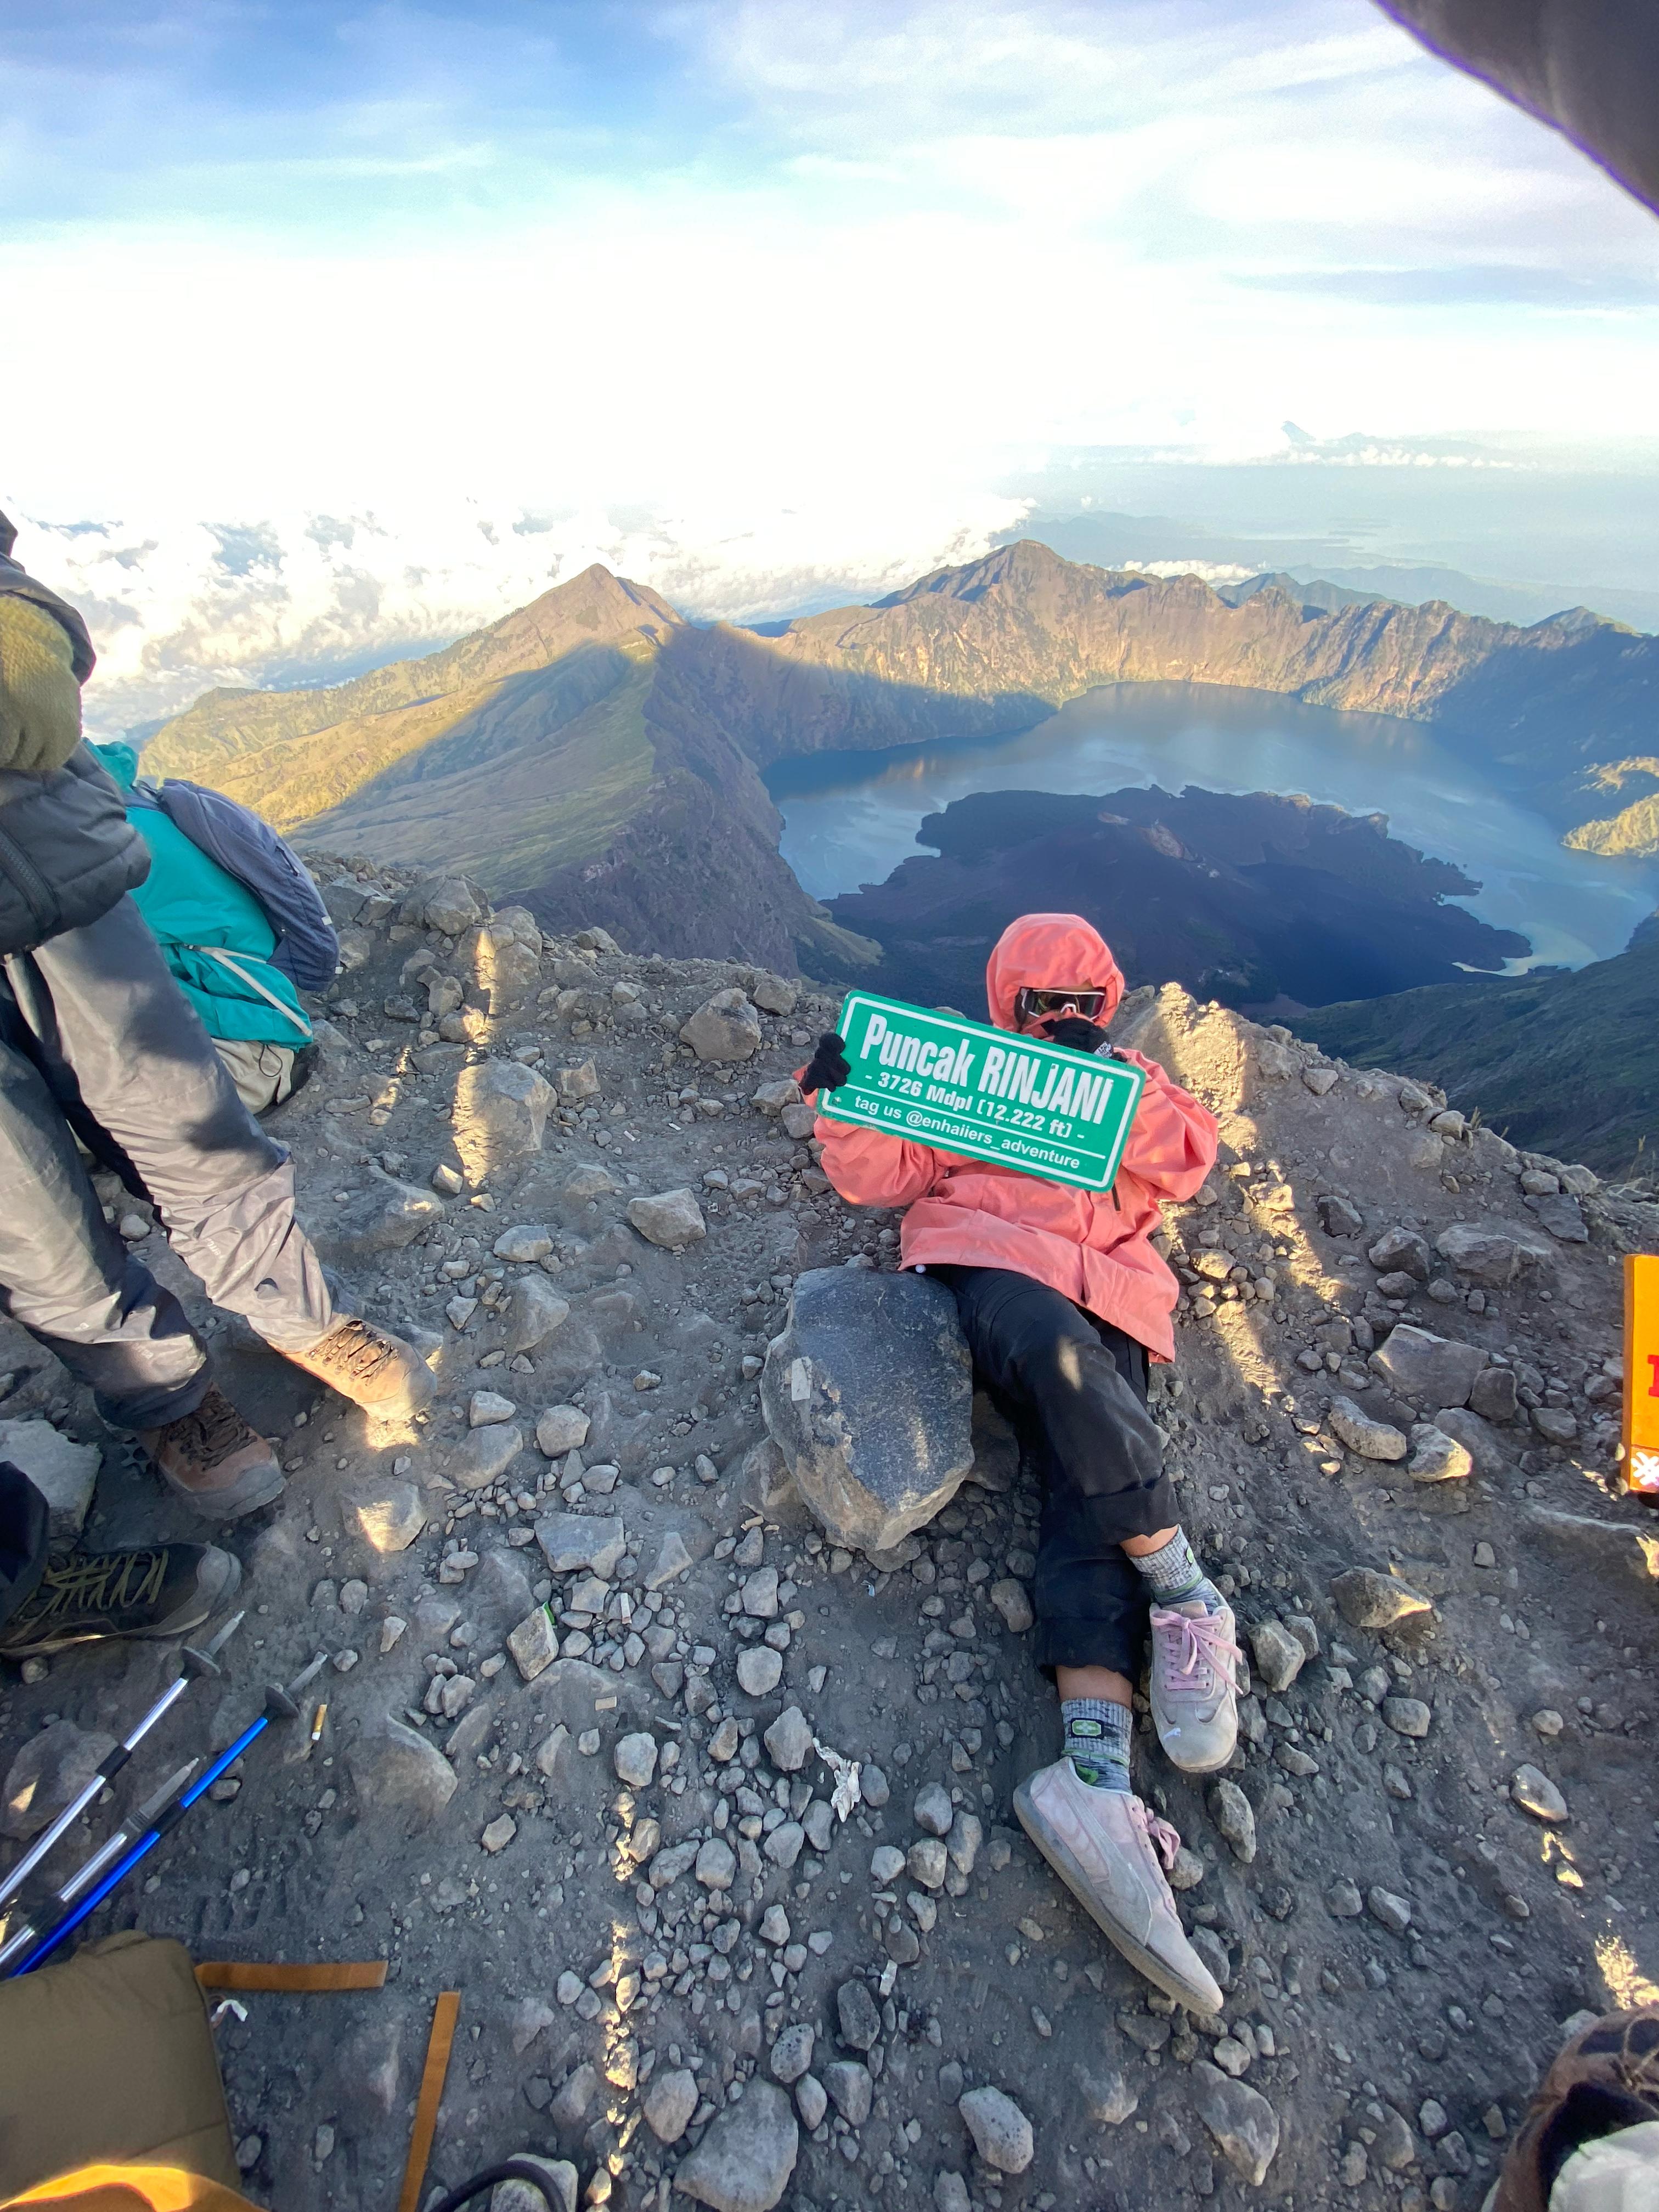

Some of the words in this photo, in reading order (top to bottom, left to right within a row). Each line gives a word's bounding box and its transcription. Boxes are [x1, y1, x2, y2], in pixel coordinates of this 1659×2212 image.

[860, 1013, 976, 1087] Puncak
[977, 1046, 1114, 1125] RINJANI
[878, 1072, 923, 1097] 3726
[926, 1084, 973, 1111] Mdpl
[855, 1096, 879, 1115] tag
[883, 1105, 901, 1119] us
[906, 1110, 1080, 1169] @enhaiiers_adventure
